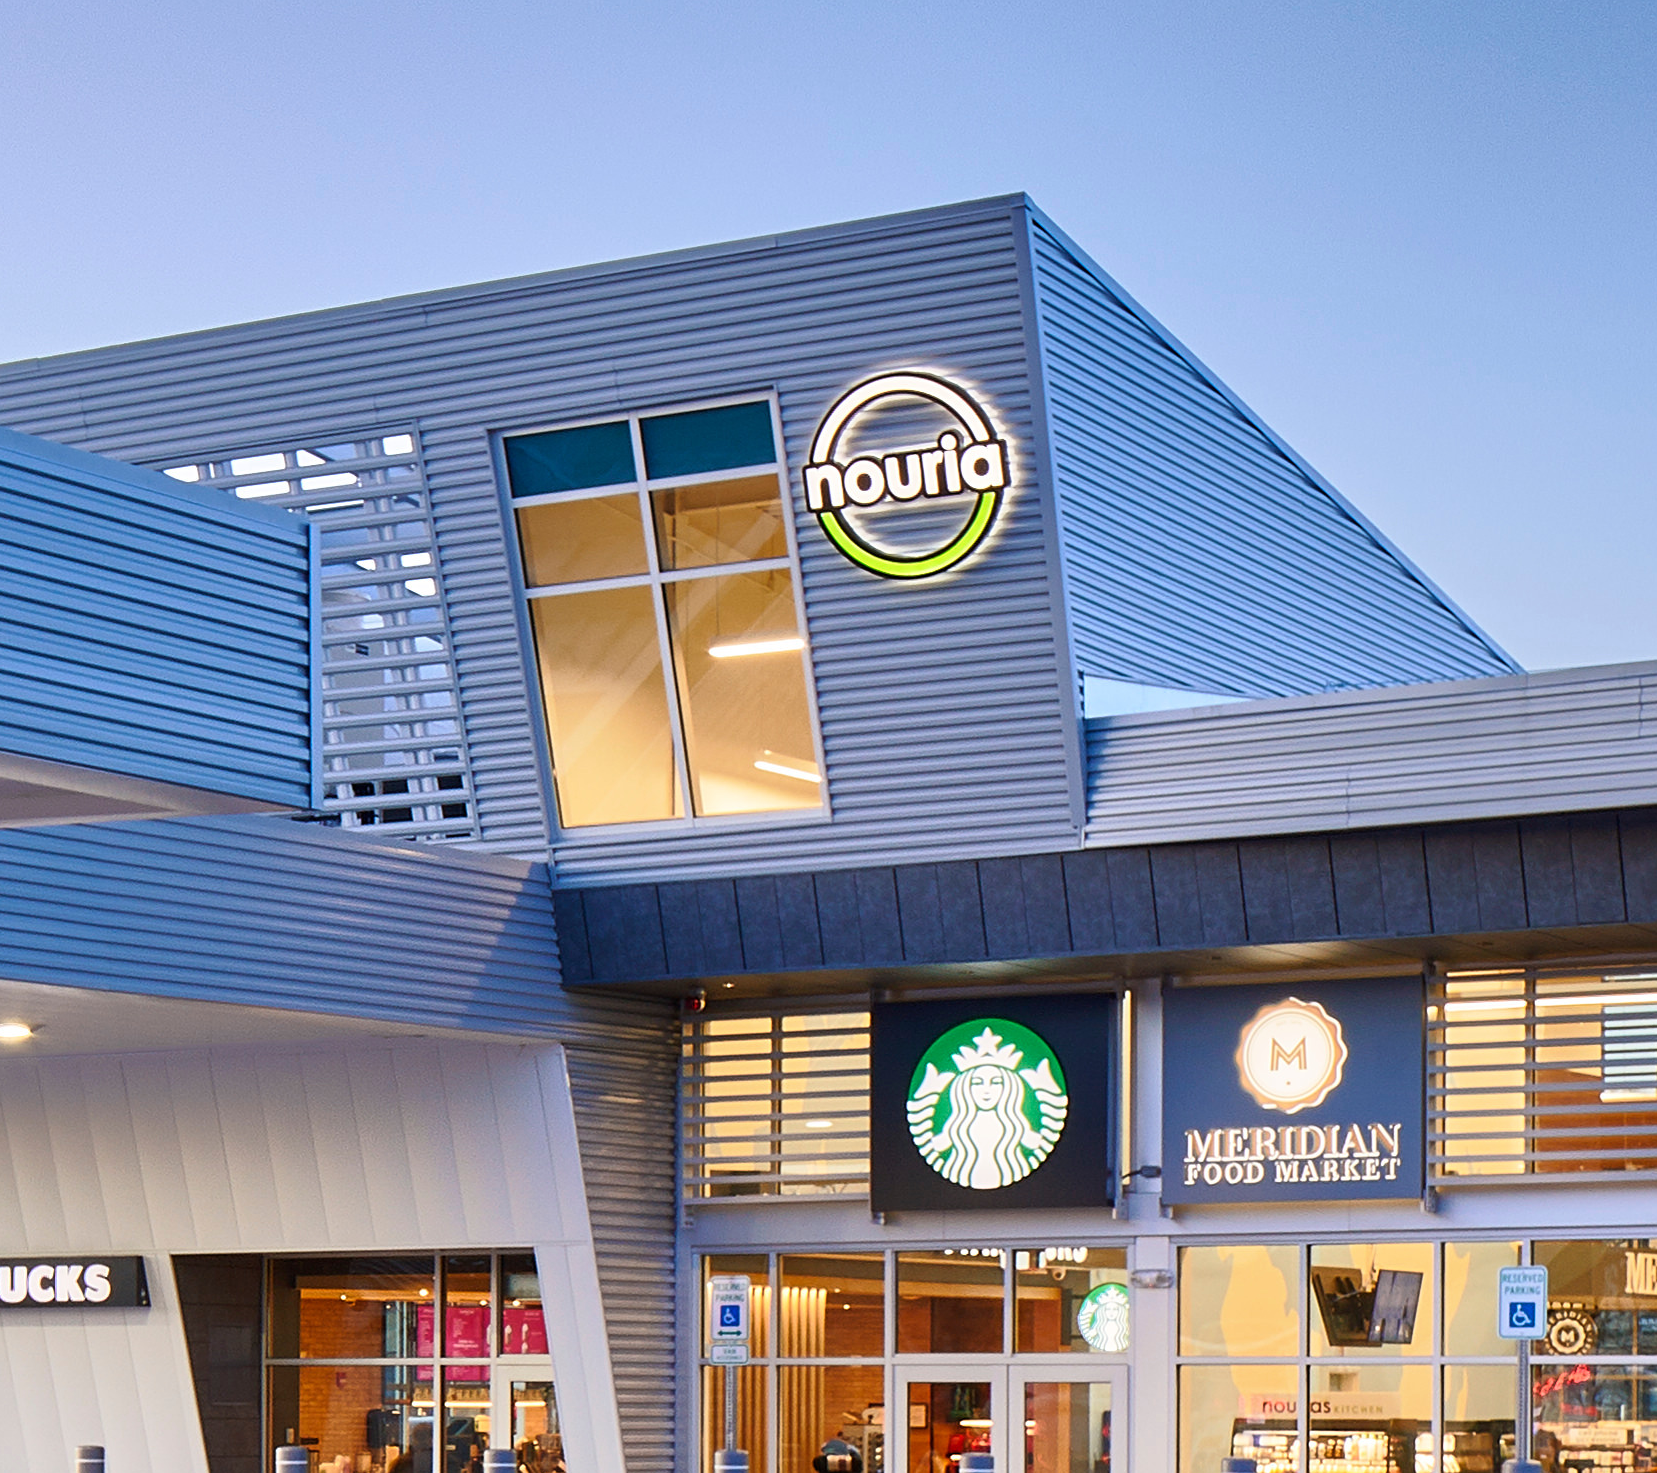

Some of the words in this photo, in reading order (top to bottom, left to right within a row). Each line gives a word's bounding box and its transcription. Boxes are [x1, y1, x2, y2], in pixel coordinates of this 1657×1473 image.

[804, 429, 1007, 512] nouria
[1270, 1036, 1307, 1072] M
[1184, 1123, 1402, 1163] MERIDIAN
[1184, 1161, 1265, 1186] FOOD
[1275, 1157, 1402, 1183] MARKET
[1502, 1273, 1544, 1283] RESERVED
[1504, 1286, 1541, 1295] PARKING
[1334, 1405, 1384, 1414] KITCHEN
